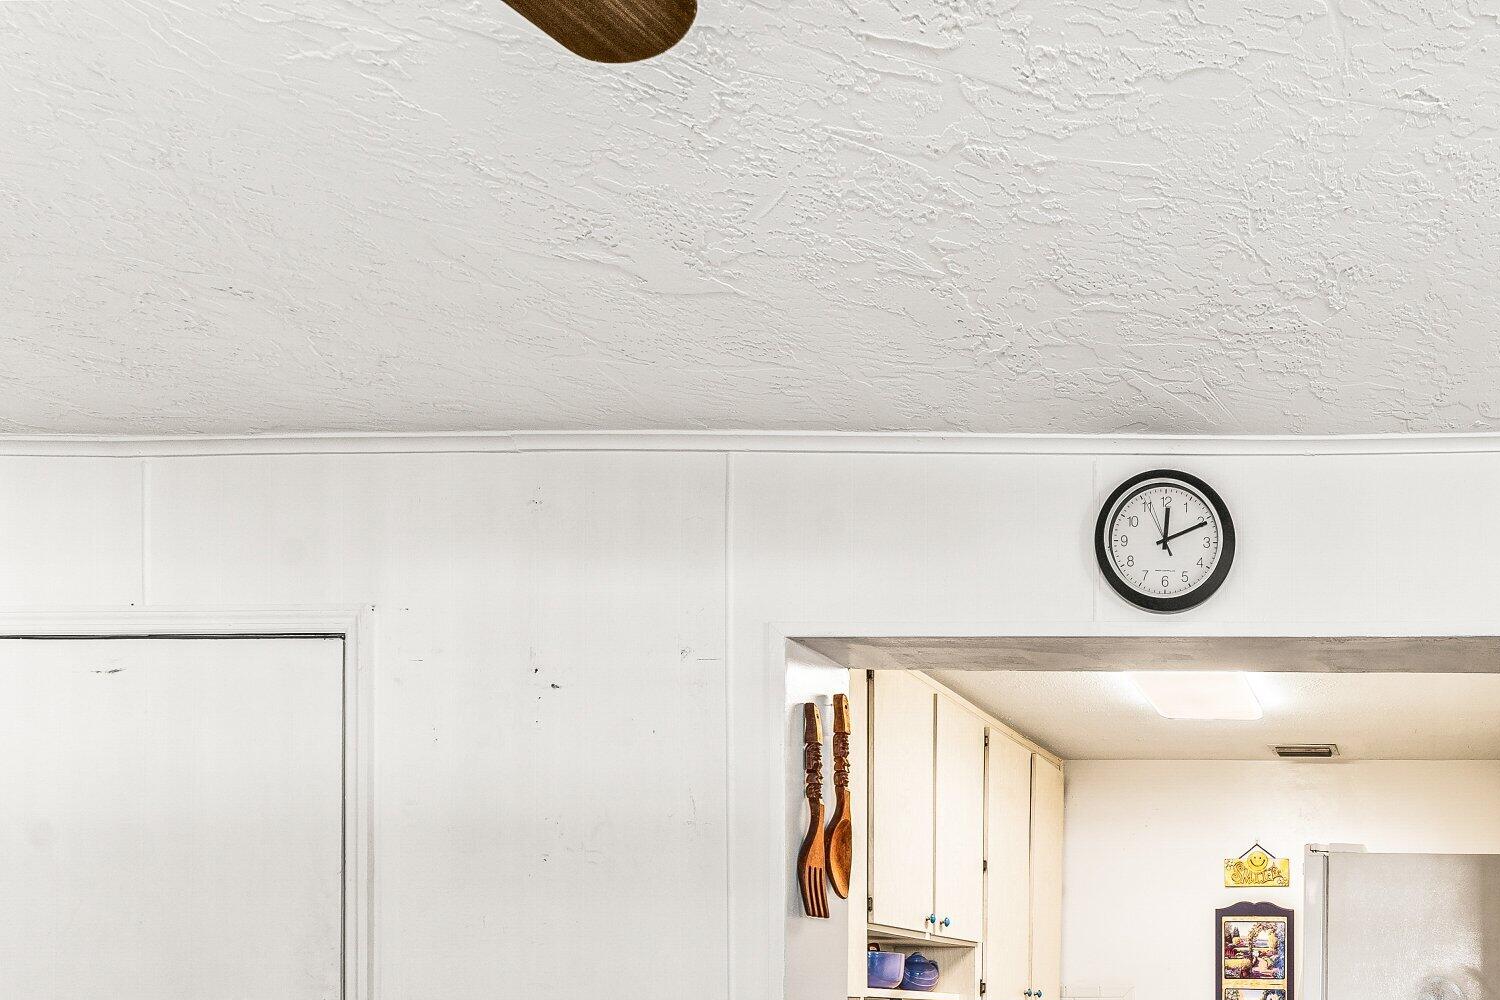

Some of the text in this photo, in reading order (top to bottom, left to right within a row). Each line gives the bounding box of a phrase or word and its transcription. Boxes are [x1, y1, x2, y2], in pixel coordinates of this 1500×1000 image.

[1142, 501, 1152, 513] 11
[1161, 496, 1173, 508] 12
[1184, 502, 1188, 513] 1
[1127, 516, 1138, 527] 10
[1121, 535, 1128, 547] 9
[1203, 537, 1210, 548] 3
[1127, 555, 1134, 567] 8
[1196, 557, 1203, 568] 4
[1142, 569, 1149, 580] 7
[1181, 571, 1188, 582] 5
[1161, 575, 1169, 587] 6
